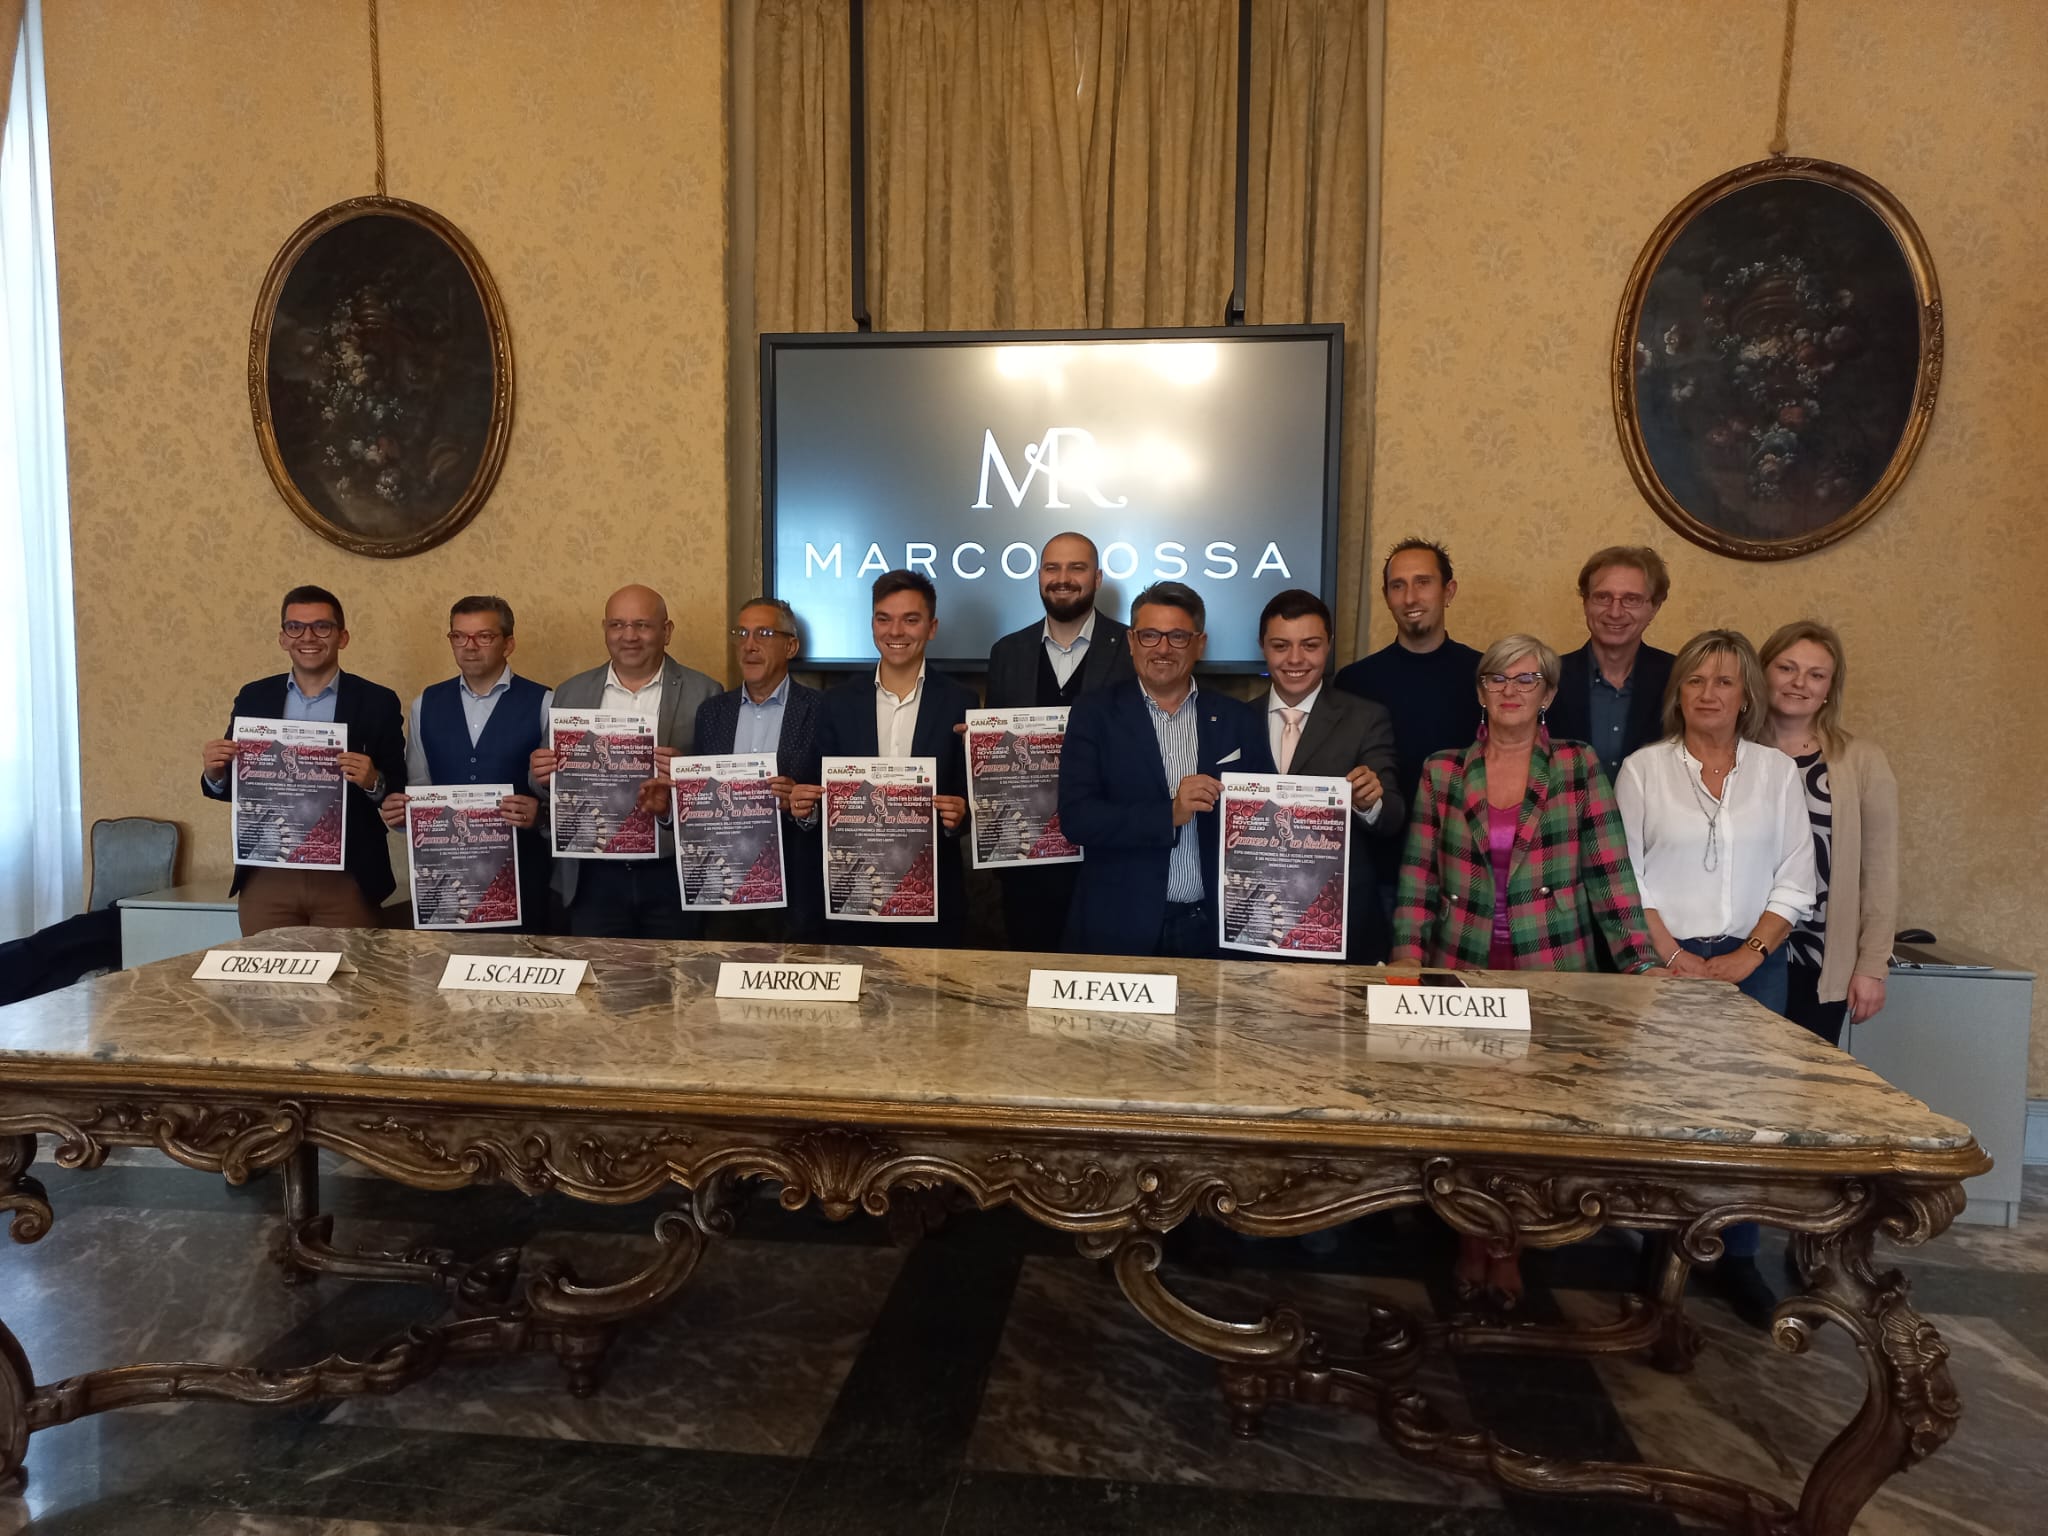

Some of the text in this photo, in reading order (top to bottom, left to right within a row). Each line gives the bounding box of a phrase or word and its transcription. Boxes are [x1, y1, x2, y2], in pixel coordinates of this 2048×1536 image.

[221, 955, 321, 975] CRISAPULLI
[464, 963, 567, 985] L.SCAFIDI
[740, 970, 842, 991] MARRONE
[1052, 979, 1155, 1004] M.FAVA
[1394, 992, 1508, 1018] A.VICARI
